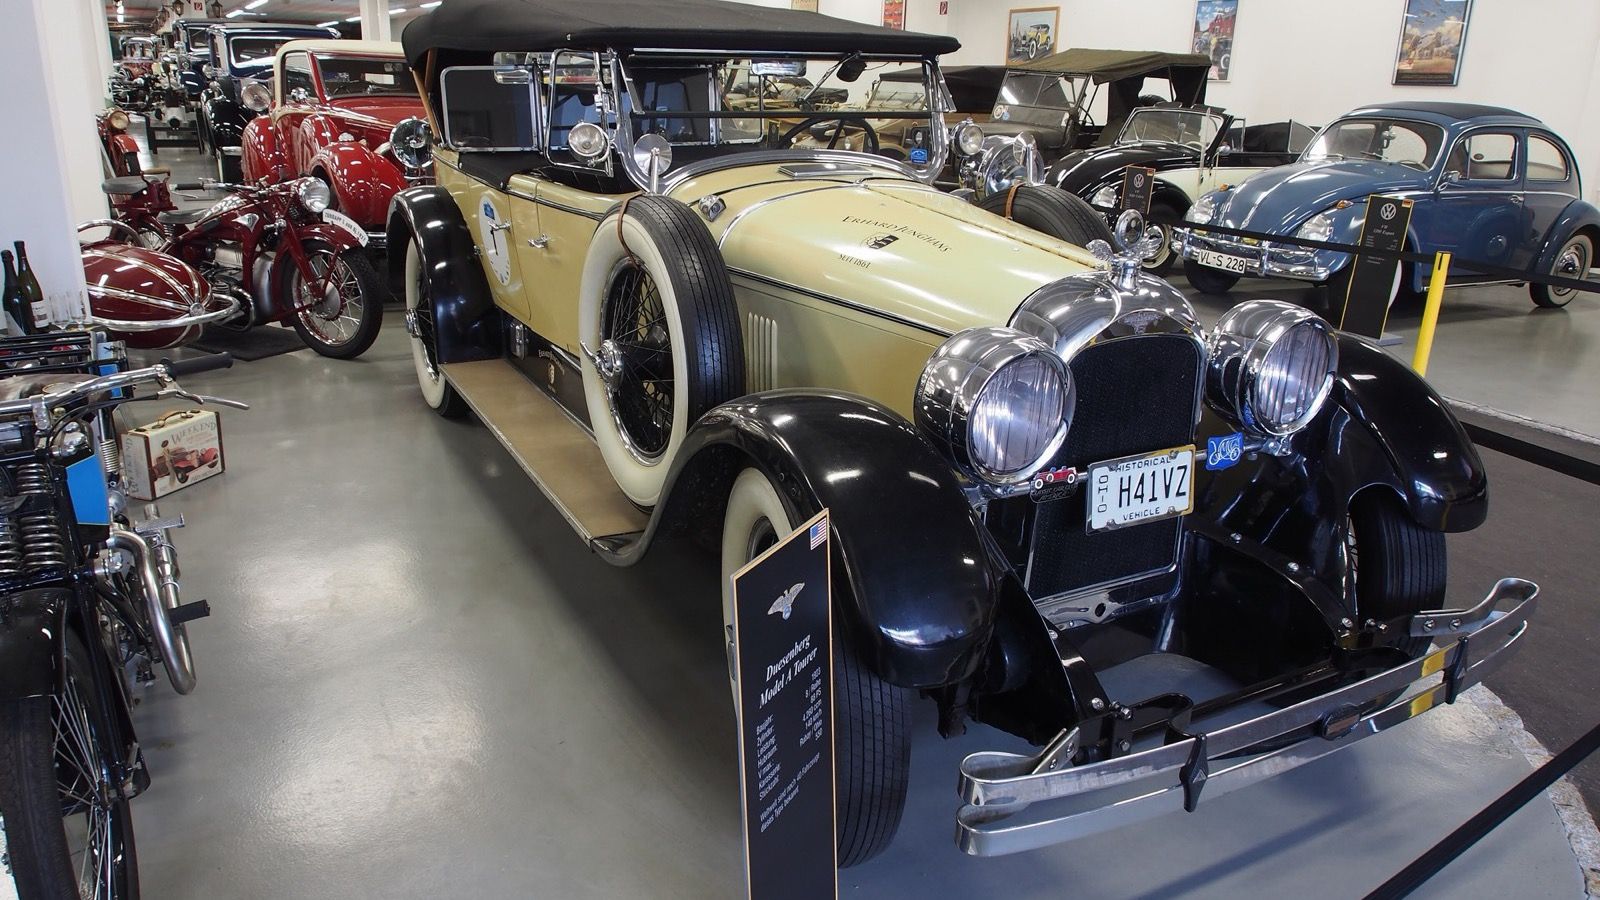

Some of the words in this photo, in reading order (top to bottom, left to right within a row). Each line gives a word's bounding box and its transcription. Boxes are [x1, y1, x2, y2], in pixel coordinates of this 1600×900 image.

[1226, 256, 1245, 272] 228
[1115, 456, 1172, 472] HISTORICAL
[1097, 474, 1109, 513] OHIO
[1118, 464, 1188, 508] H41VZ
[1122, 506, 1161, 521] VEHICLE
[766, 634, 811, 682] Duesenberg
[760, 673, 785, 710] Model
[785, 667, 793, 685] A
[793, 647, 818, 677] Tourer
